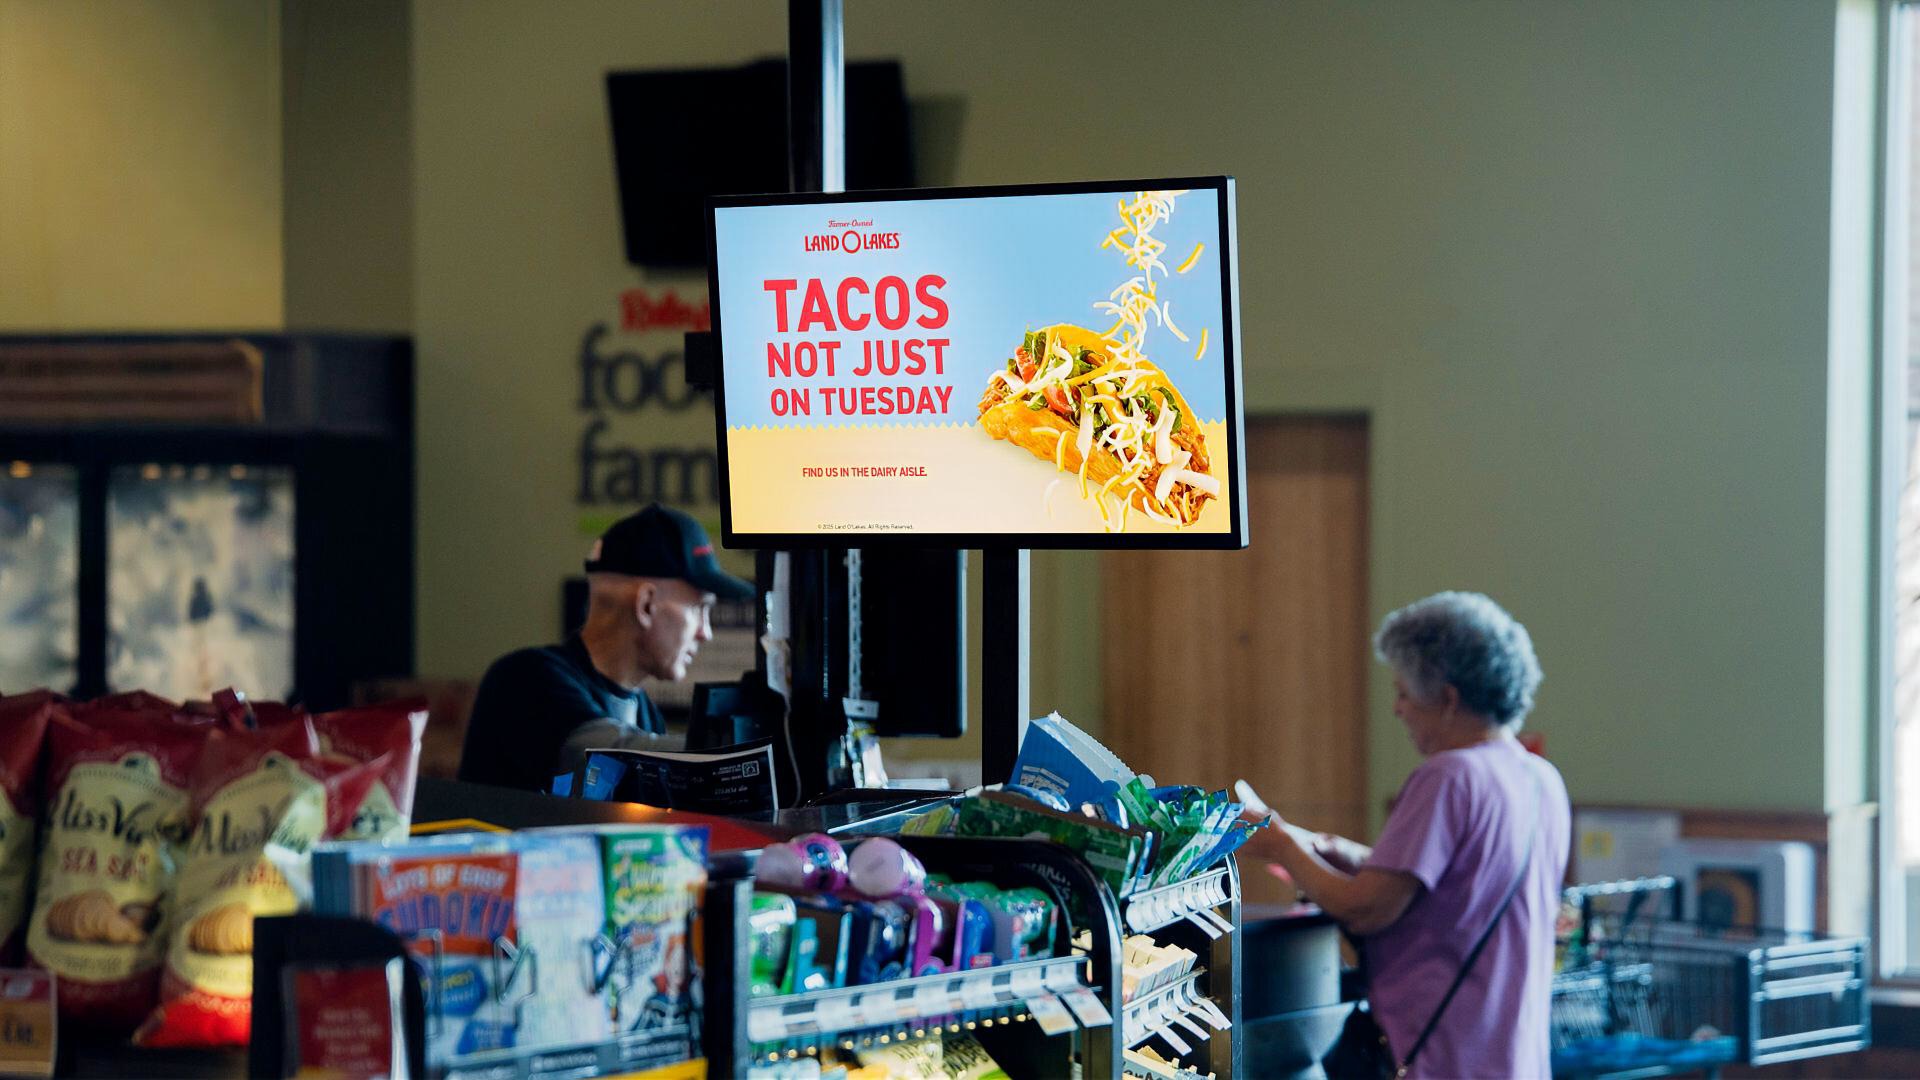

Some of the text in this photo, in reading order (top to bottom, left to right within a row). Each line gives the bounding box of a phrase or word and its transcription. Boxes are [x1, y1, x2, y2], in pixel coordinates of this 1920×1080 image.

[828, 218, 874, 228] Farmer-Owned
[804, 230, 900, 254] LAND O LAKES
[763, 274, 950, 333] TACOS
[577, 320, 715, 412] foo
[767, 338, 950, 378] NOT JUST
[770, 385, 954, 417] ON TUESDAY
[802, 466, 928, 478] FIND US IN THE DAIRY AISLE.
[431, 863, 457, 888] OF
